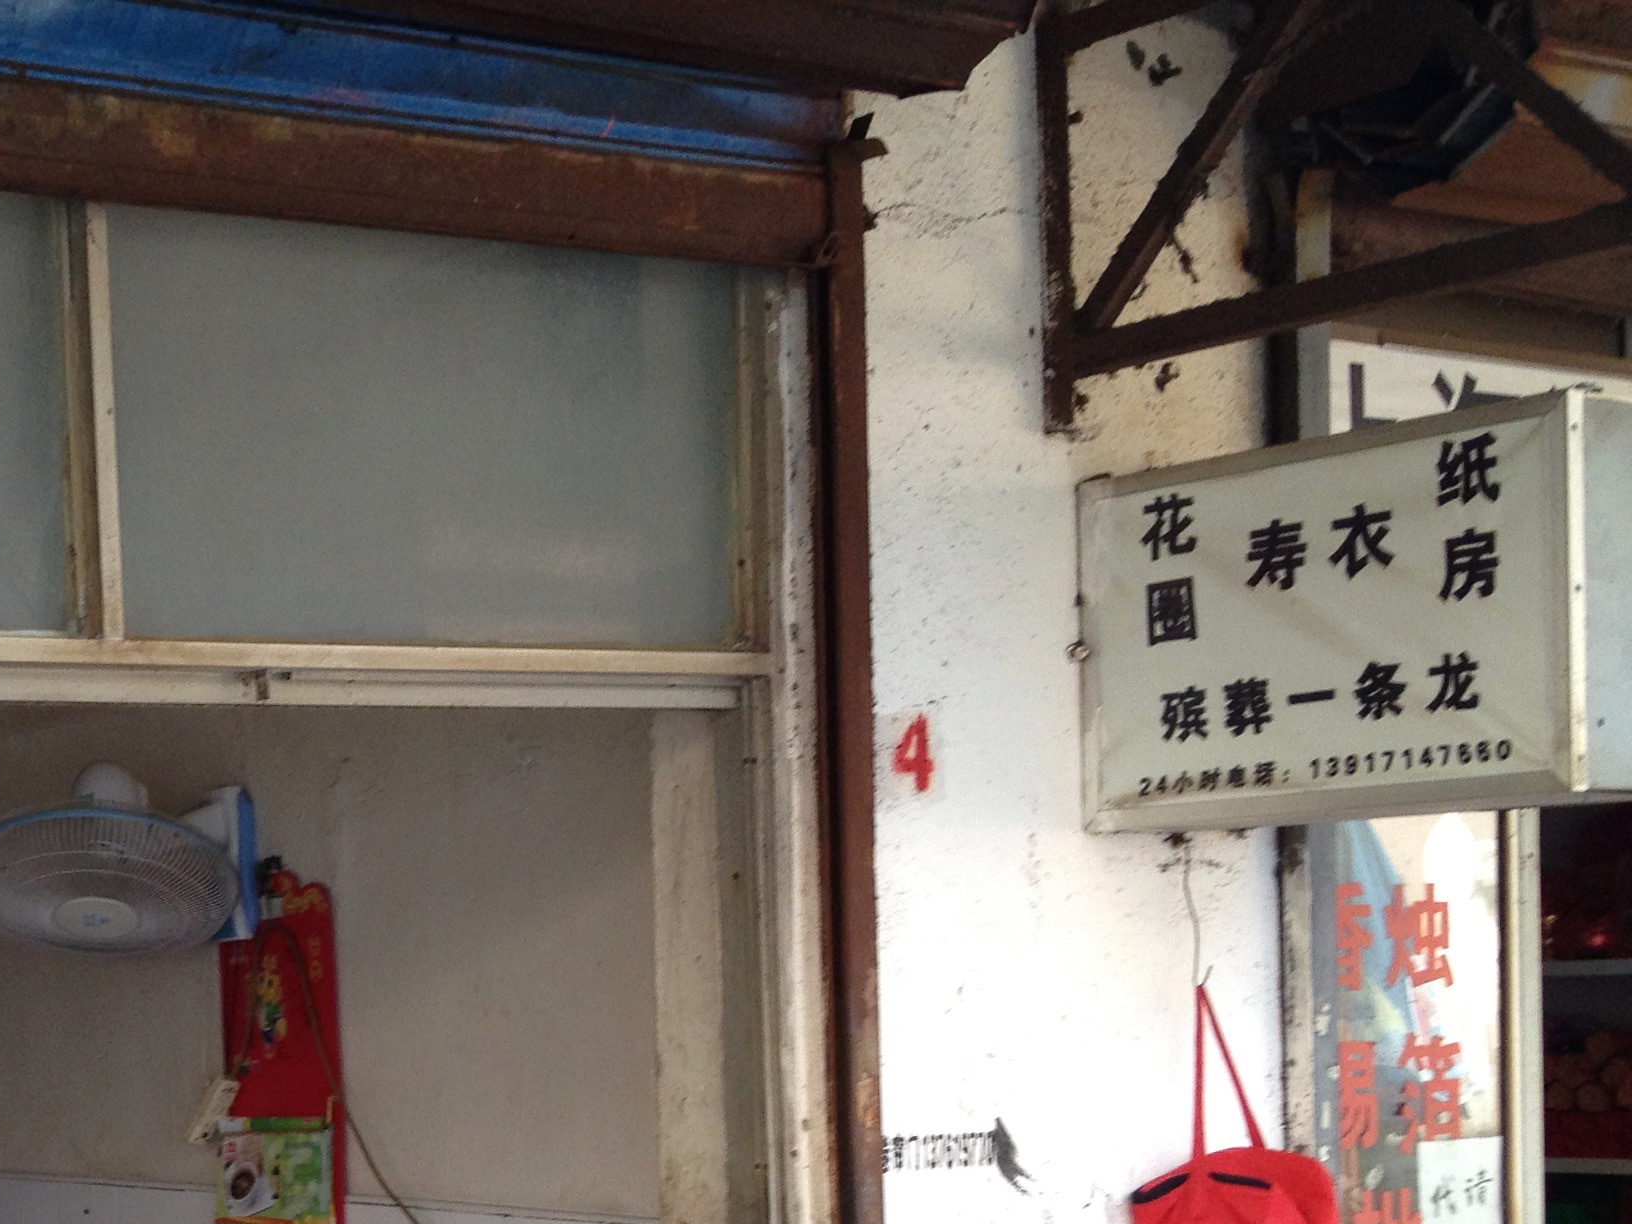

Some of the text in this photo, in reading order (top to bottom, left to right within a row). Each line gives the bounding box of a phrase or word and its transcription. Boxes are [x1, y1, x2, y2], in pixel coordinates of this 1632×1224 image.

[1159, 650, 1480, 744] 殡葬一条龙
[892, 713, 935, 792] 4
